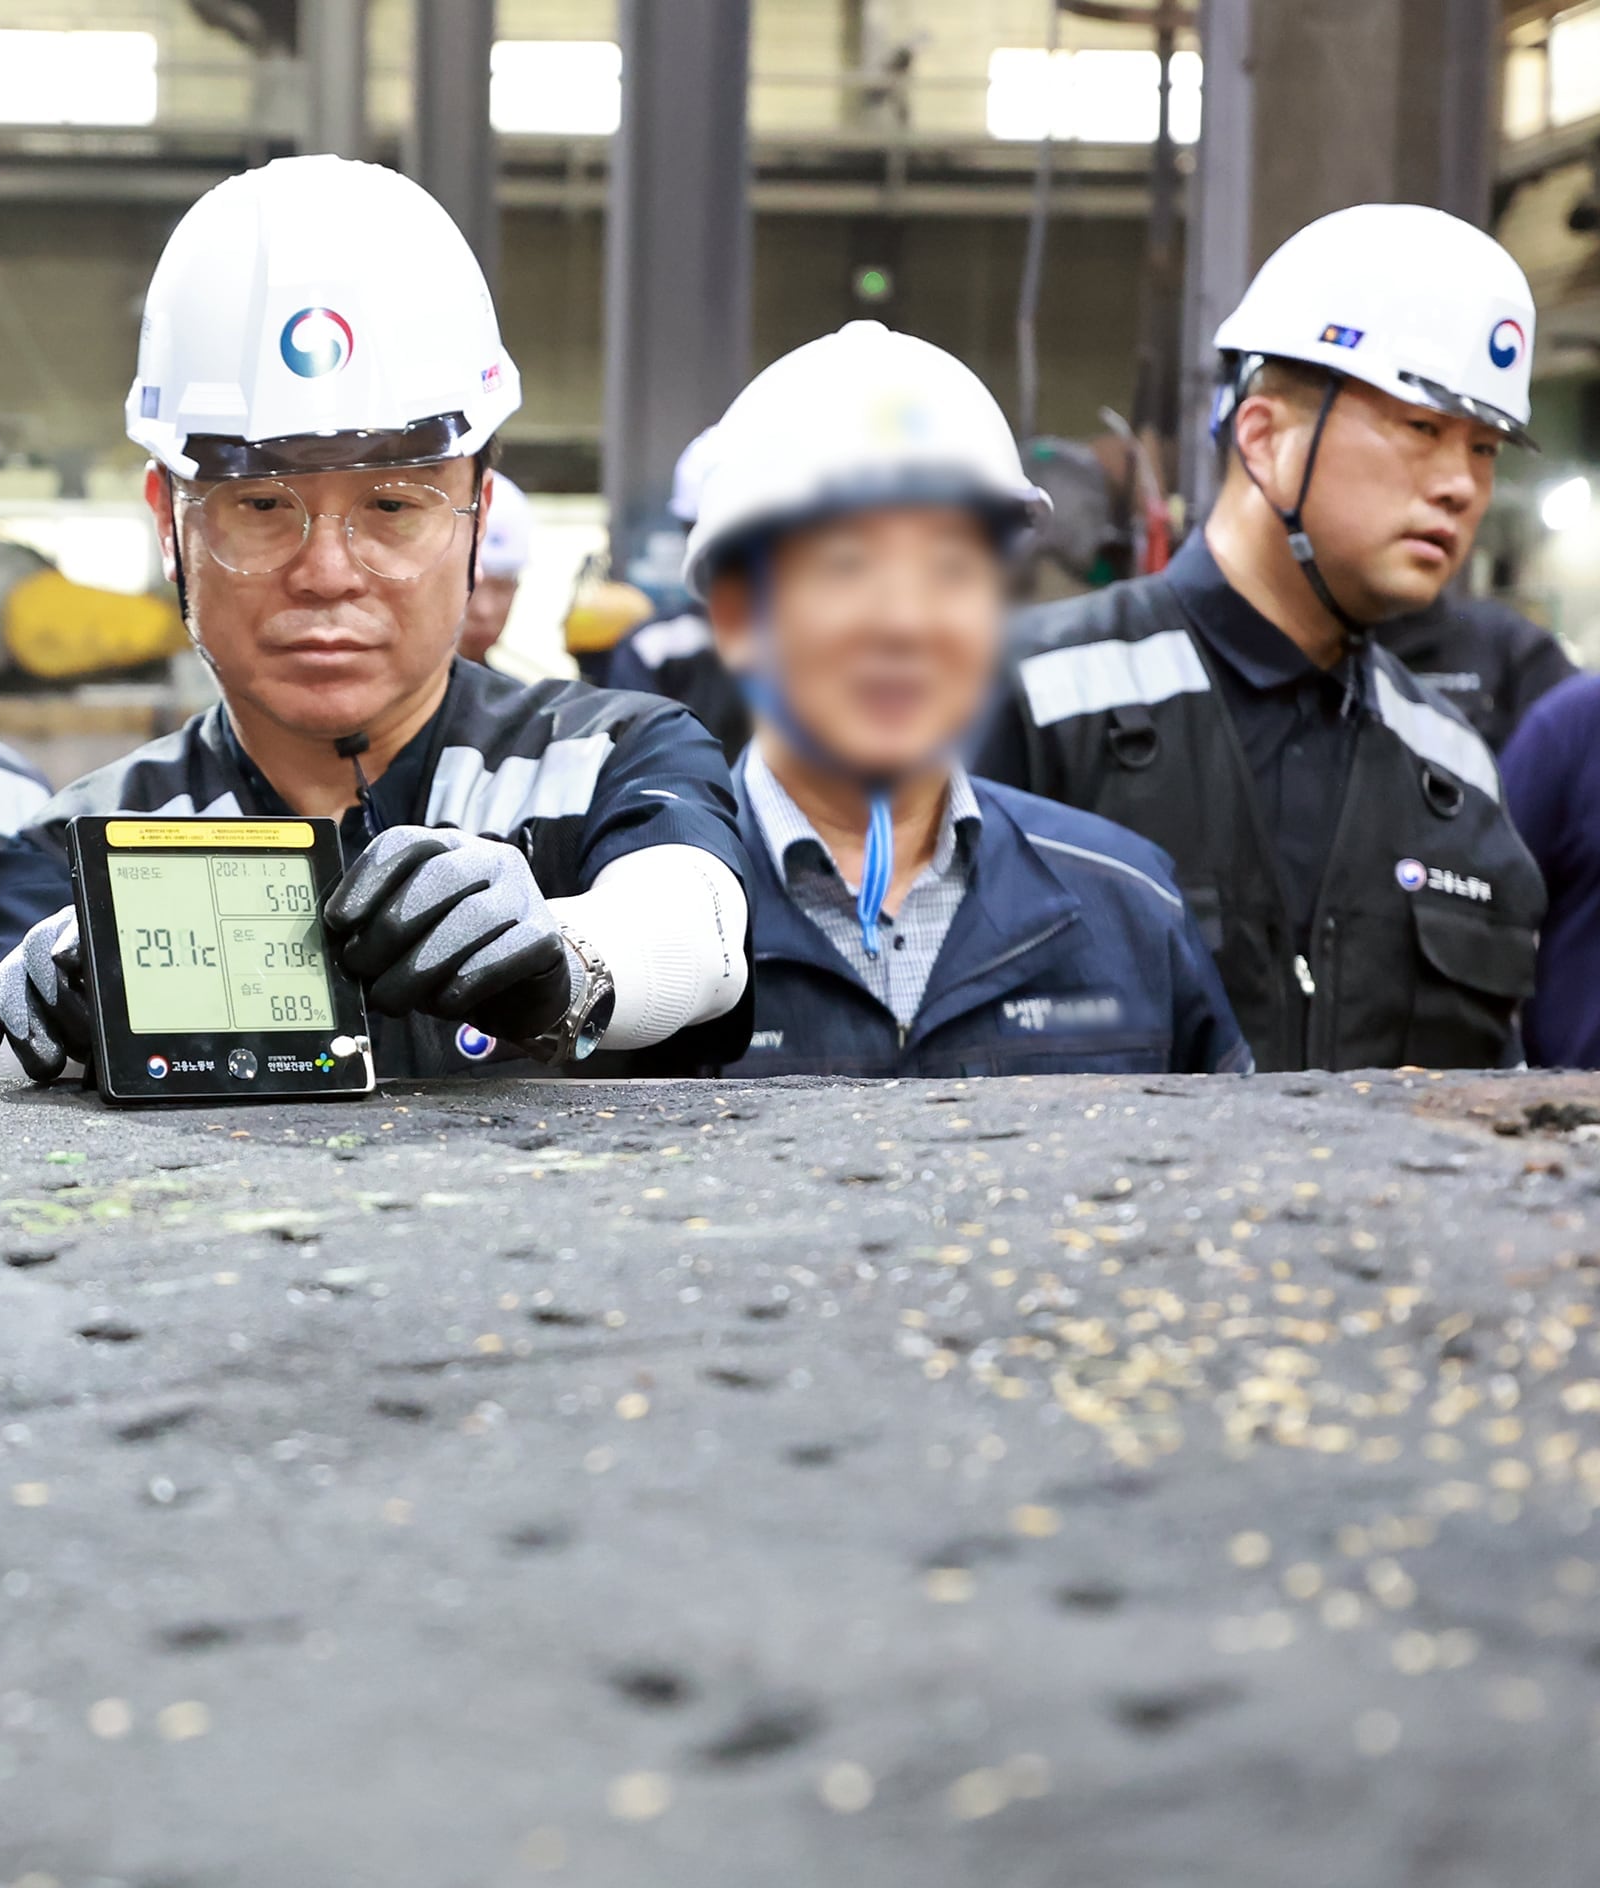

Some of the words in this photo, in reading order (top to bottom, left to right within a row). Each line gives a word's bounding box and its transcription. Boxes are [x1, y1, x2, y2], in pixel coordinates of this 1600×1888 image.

[117, 866, 162, 880] 체감온도
[266, 884, 312, 912] 5:09
[232, 928, 256, 942] 온도
[241, 983, 264, 997] 습도
[270, 995, 327, 1022] 68.9%
[172, 1060, 215, 1072] 고용노동부
[267, 1061, 313, 1072] 안전보건공단
